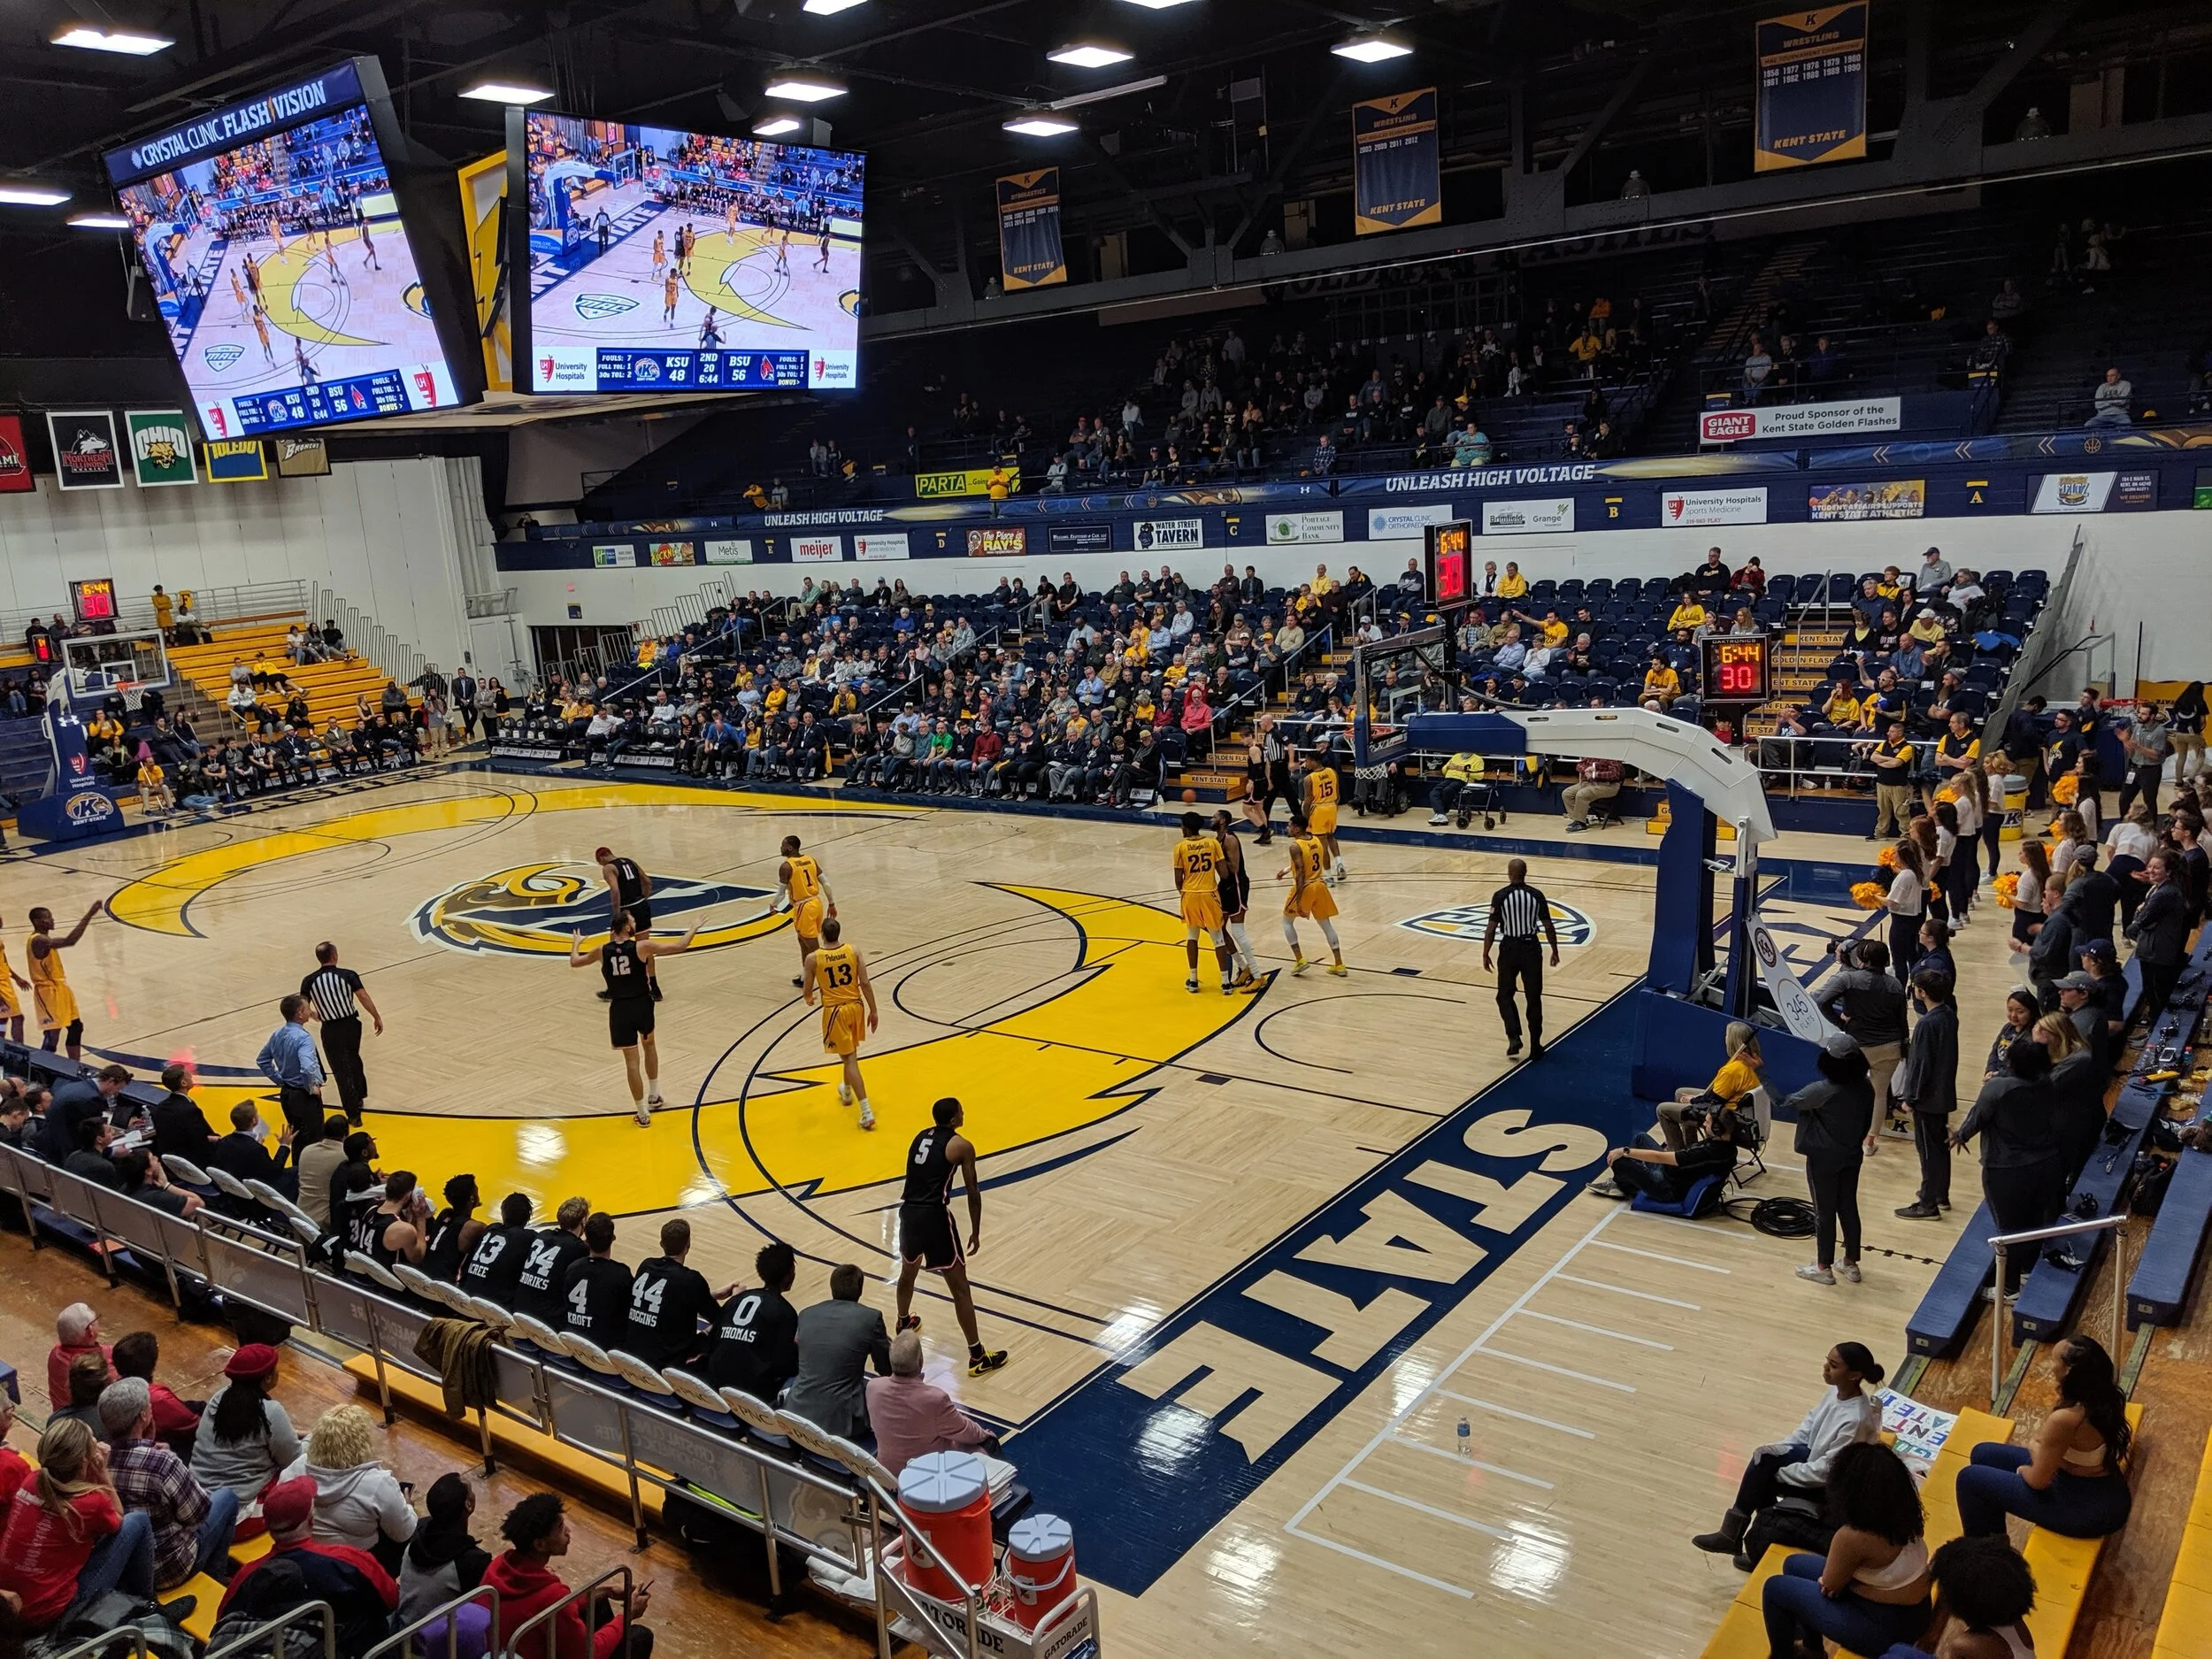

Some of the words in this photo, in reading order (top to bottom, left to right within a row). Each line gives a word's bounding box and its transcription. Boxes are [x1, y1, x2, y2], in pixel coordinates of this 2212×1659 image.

[1784, 32, 1839, 48] WRESTLING
[141, 138, 189, 166] CRYSTAL
[187, 119, 224, 150] CLINIC
[223, 101, 271, 138] FLASH
[273, 81, 326, 120] VISION
[1373, 113, 1417, 128] WRESTLING
[1774, 136, 1806, 149] KENT
[1808, 130, 1846, 143] STATE
[1371, 204, 1394, 215] KENT
[1396, 198, 1425, 210] STATE
[665, 357, 689, 367] KSU
[729, 357, 750, 366] BSU
[373, 377, 390, 386] FOULS:
[669, 370, 685, 380] 48
[699, 374, 718, 383] 6:44
[732, 370, 746, 380] 56
[306, 386, 319, 396] 2ND
[328, 386, 343, 397] BSU
[286, 394, 301, 405] KSU
[311, 398, 320, 408] 20
[334, 400, 348, 412] 56
[379, 403, 398, 412] BONUS
[292, 407, 304, 419] 48
[314, 409, 328, 420] 6:44
[1775, 411, 1804, 421] Proud
[1808, 410, 1850, 421] Sponsor
[1867, 405, 1884, 414] the
[1708, 417, 1750, 427] GIANT
[1788, 422, 1814, 431] State
[1818, 419, 1854, 429] Golden
[1858, 417, 1897, 426] Flashes
[1709, 426, 1749, 436] EAGLE
[135, 426, 188, 460] OHIO
[209, 441, 257, 459] TOLEDO
[64, 452, 111, 464] NORTHERN
[920, 475, 965, 492] PARTA
[1386, 472, 1463, 492] UNLEASH
[1466, 470, 1512, 488] HIGH
[1514, 465, 1595, 483] VOLTAGE
[1726, 495, 1762, 504] Hospitals
[1970, 491, 1983, 503] A
[764, 514, 810, 526] UNLEASH
[811, 512, 836, 524] HIGH
[838, 511, 883, 522] VOLTAGE
[1609, 506, 1618, 518] B
[1811, 511, 1836, 519] KENT
[1839, 510, 1868, 519] STATE
[1869, 508, 1923, 518] ATHLETICS
[983, 531, 995, 540] The
[1156, 529, 1198, 543] TAVERN
[1230, 526, 1237, 535] C
[718, 545, 739, 556] Metis
[800, 540, 833, 559] meijer
[984, 539, 1023, 551] RAY'S
[1440, 532, 1463, 554] 6:44
[82, 581, 110, 595] 6:44
[82, 595, 109, 617] 30
[180, 594, 190, 606] F
[1722, 646, 1759, 663] 6:44
[1723, 666, 1751, 689] 30
[1319, 781, 1333, 798] 15
[1187, 852, 1211, 873] 25
[1312, 853, 1320, 872] 3
[622, 864, 634, 879] 11
[803, 869, 812, 887] 1
[611, 956, 631, 976] 12
[824, 963, 853, 989] 13
[1786, 995, 1809, 1021] 345
[1800, 1014, 1814, 1030] FLATS
[914, 1139, 933, 1164] 5
[359, 1225, 376, 1256] 14
[472, 1232, 506, 1264] 13
[525, 1239, 562, 1278] 34
[632, 1272, 667, 1314] 44
[1115, 1110, 1608, 1465] STATE
[568, 1279, 588, 1314] 4
[733, 1295, 762, 1326] 0
[567, 1312, 593, 1327] KROFT
[720, 1326, 757, 1343] THOMAS
[738, 1404, 773, 1426] PNC
[795, 1429, 830, 1451] PNC
[1044, 1616, 1088, 1659] GATORADE
